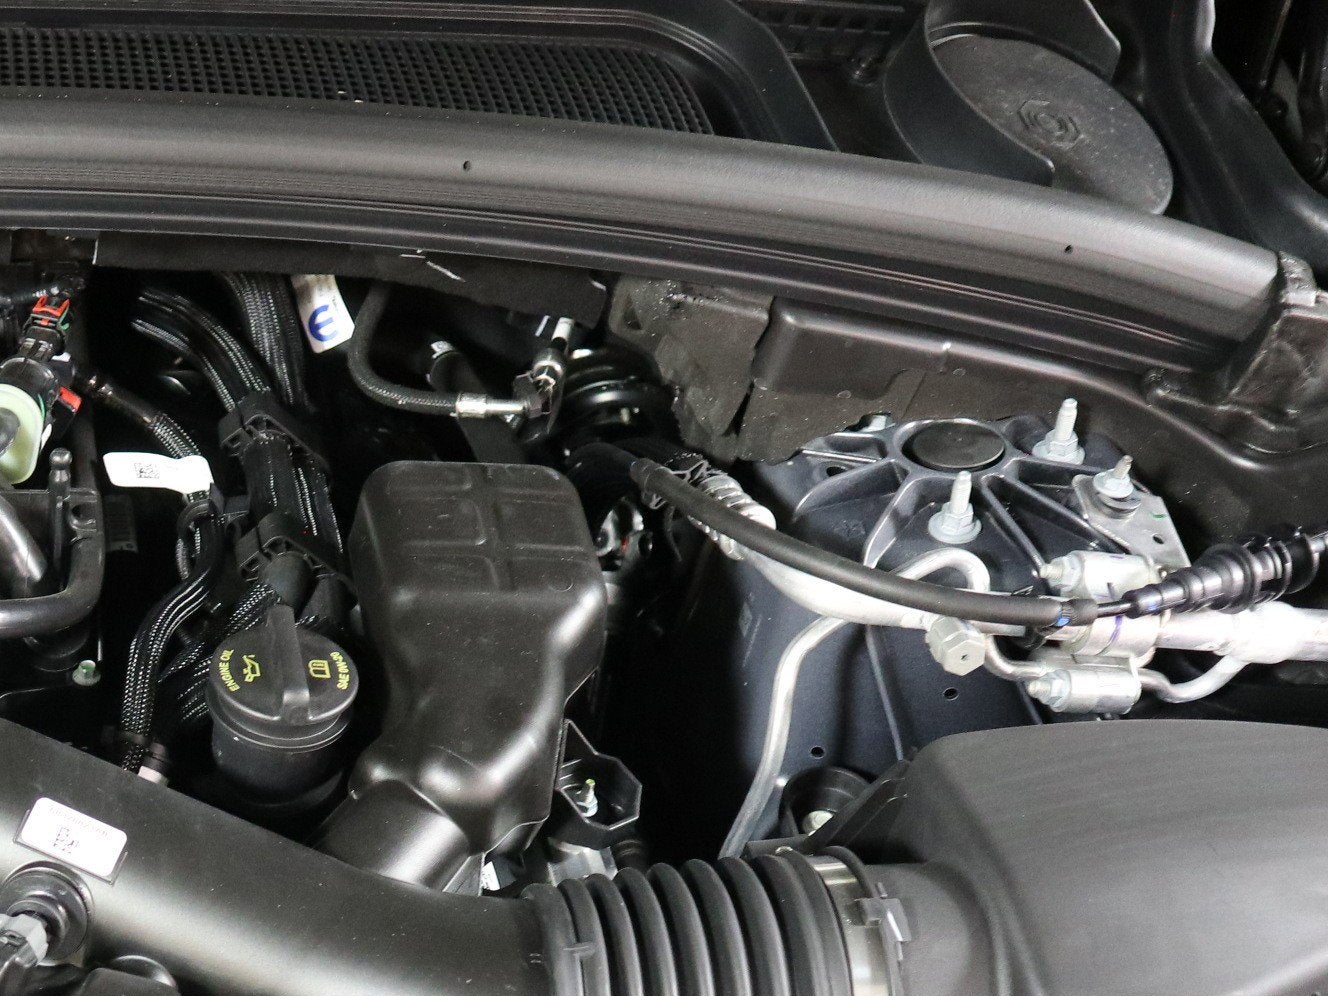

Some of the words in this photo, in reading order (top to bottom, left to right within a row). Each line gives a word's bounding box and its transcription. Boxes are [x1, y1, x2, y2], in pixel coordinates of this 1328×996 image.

[220, 649, 234, 661] OIL
[219, 661, 240, 692] ENGINE
[337, 673, 350, 690] SAE
